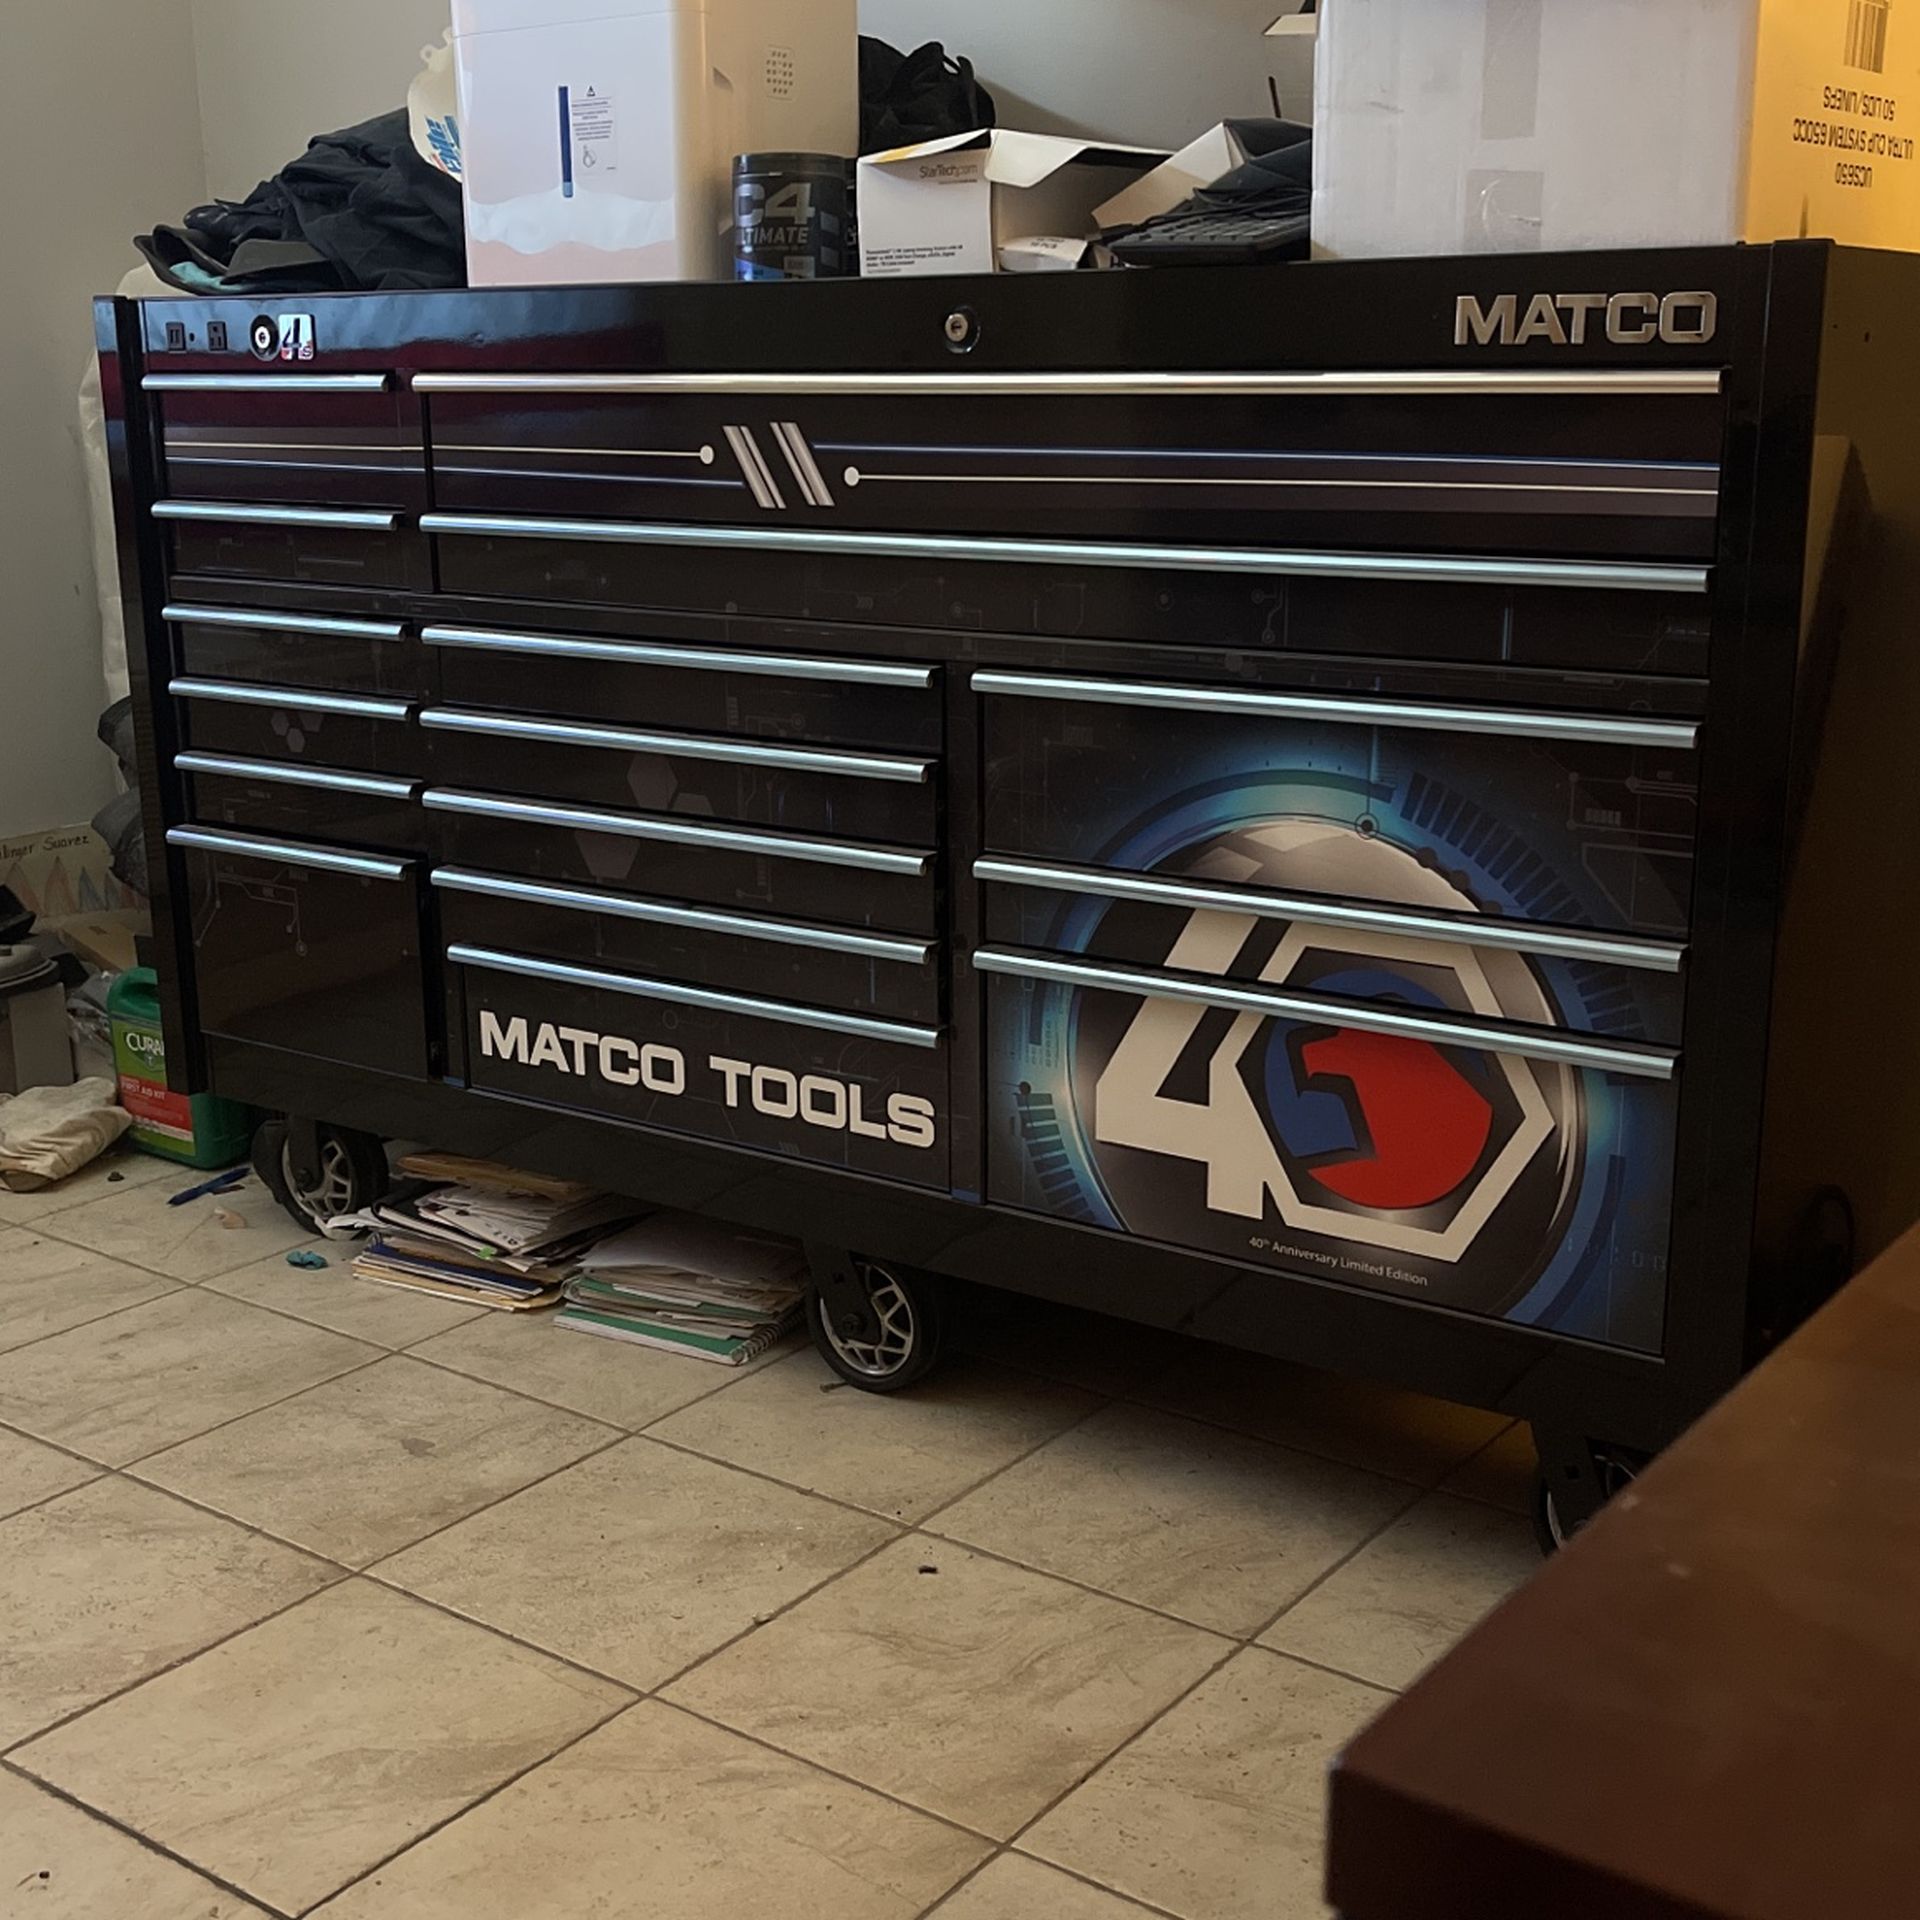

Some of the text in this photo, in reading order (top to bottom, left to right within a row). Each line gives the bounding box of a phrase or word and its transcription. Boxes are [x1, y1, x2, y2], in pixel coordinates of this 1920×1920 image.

[1883, 99, 1895, 121] 50
[1793, 118, 1914, 160] ULTRA CUP SYSTEM 650CC
[1834, 162, 1873, 188] UCS650
[734, 182, 816, 227] C4
[1454, 290, 1718, 345] MATCO
[478, 1009, 936, 1150] MATCO TOOLS
[1272, 1241, 1339, 1269] Anniversary
[1339, 1256, 1384, 1278] Limited
[1385, 1266, 1429, 1287] Edition
